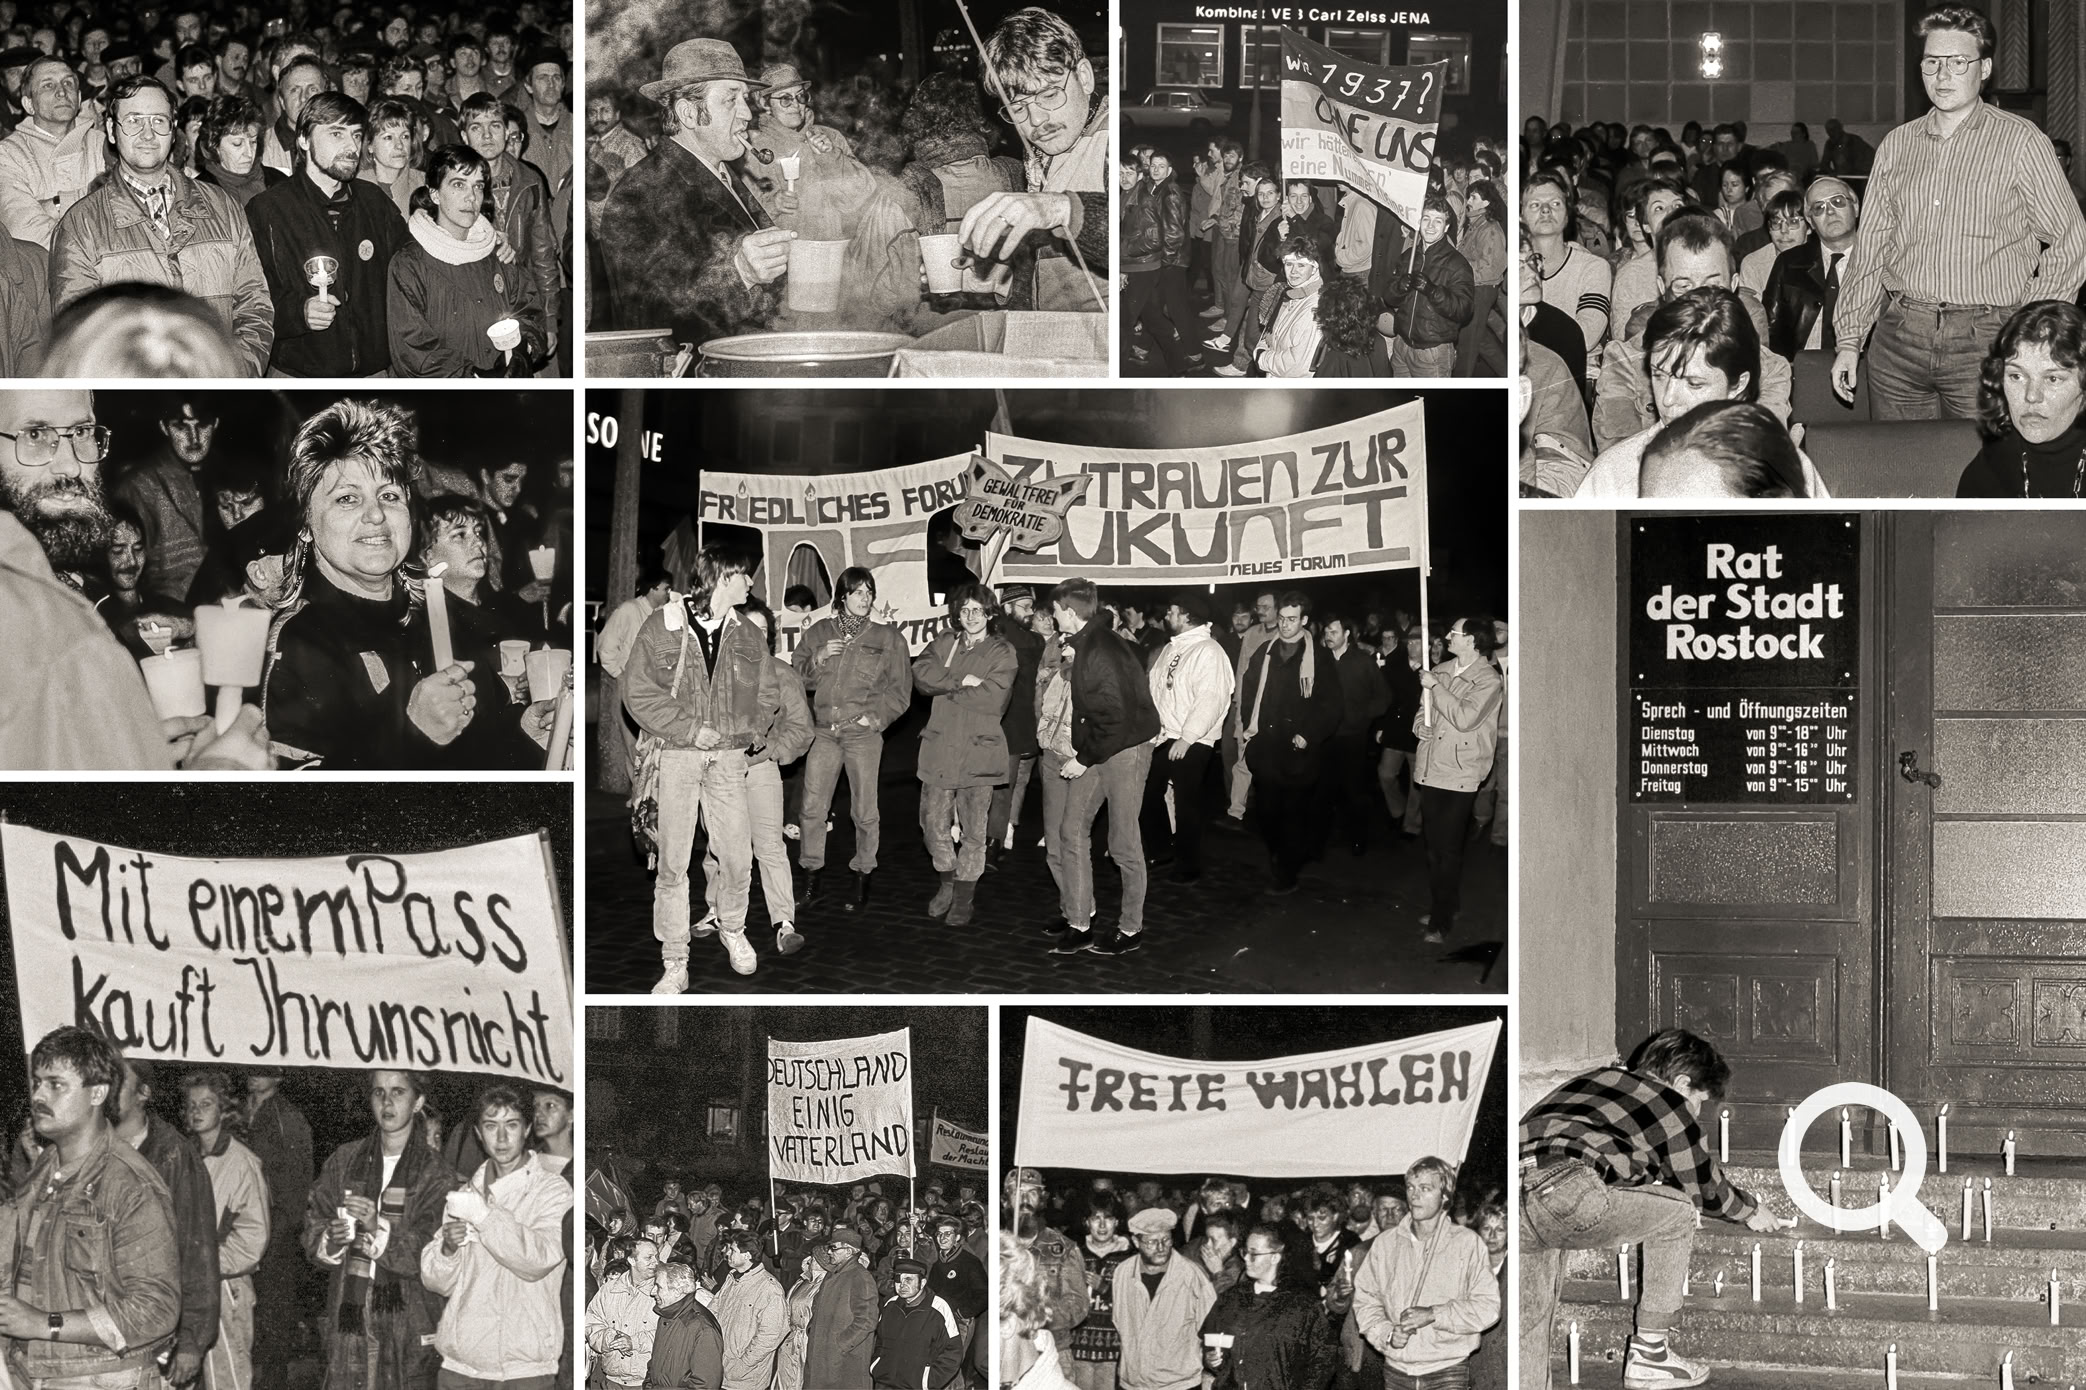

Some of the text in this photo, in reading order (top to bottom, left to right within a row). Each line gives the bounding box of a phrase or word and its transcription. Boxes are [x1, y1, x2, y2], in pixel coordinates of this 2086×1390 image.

[1309, 8, 1341, 21] Carl
[1346, 9, 1387, 23] Zeiss
[1390, 11, 1431, 24] JENA
[1322, 64, 1434, 114] 1937?
[1281, 131, 1310, 150] wir
[1290, 154, 1327, 175] eine
[1311, 428, 1408, 496] ZUR
[901, 471, 969, 517] FORU
[983, 478, 1059, 506] GEWALTFREI
[971, 503, 1047, 532] DEMOKRATIE
[1291, 553, 1347, 572] FORUM
[1706, 543, 1783, 579] Rat
[1646, 582, 1844, 621] der Stadt
[1666, 623, 1825, 661] Rostock
[1641, 701, 1686, 721] Sprech
[1707, 702, 1731, 719] und
[1739, 698, 1848, 722] Öffnungszeiten
[1641, 726, 1695, 742] Dienstag
[1745, 729, 1766, 740] von
[1826, 725, 1847, 740] Uhr
[1641, 743, 1700, 758] Mittwoch
[1745, 746, 1766, 757] von
[1826, 743, 1847, 757] Uhr
[1641, 760, 1708, 777] Donnerstag
[1745, 763, 1766, 775] von
[1826, 760, 1847, 775] Uhr
[1641, 778, 1681, 794] Freitag
[1745, 781, 1766, 792] von
[1826, 778, 1847, 792] Uhr
[54, 839, 171, 952] Mit
[767, 1050, 908, 1091] DEUTSCHLAND
[1057, 1050, 1472, 1112] FREIE WAHLEN
[792, 1092, 854, 1129] EINIG
[773, 1123, 908, 1167] VATERLAND
[942, 1151, 958, 1161] der
